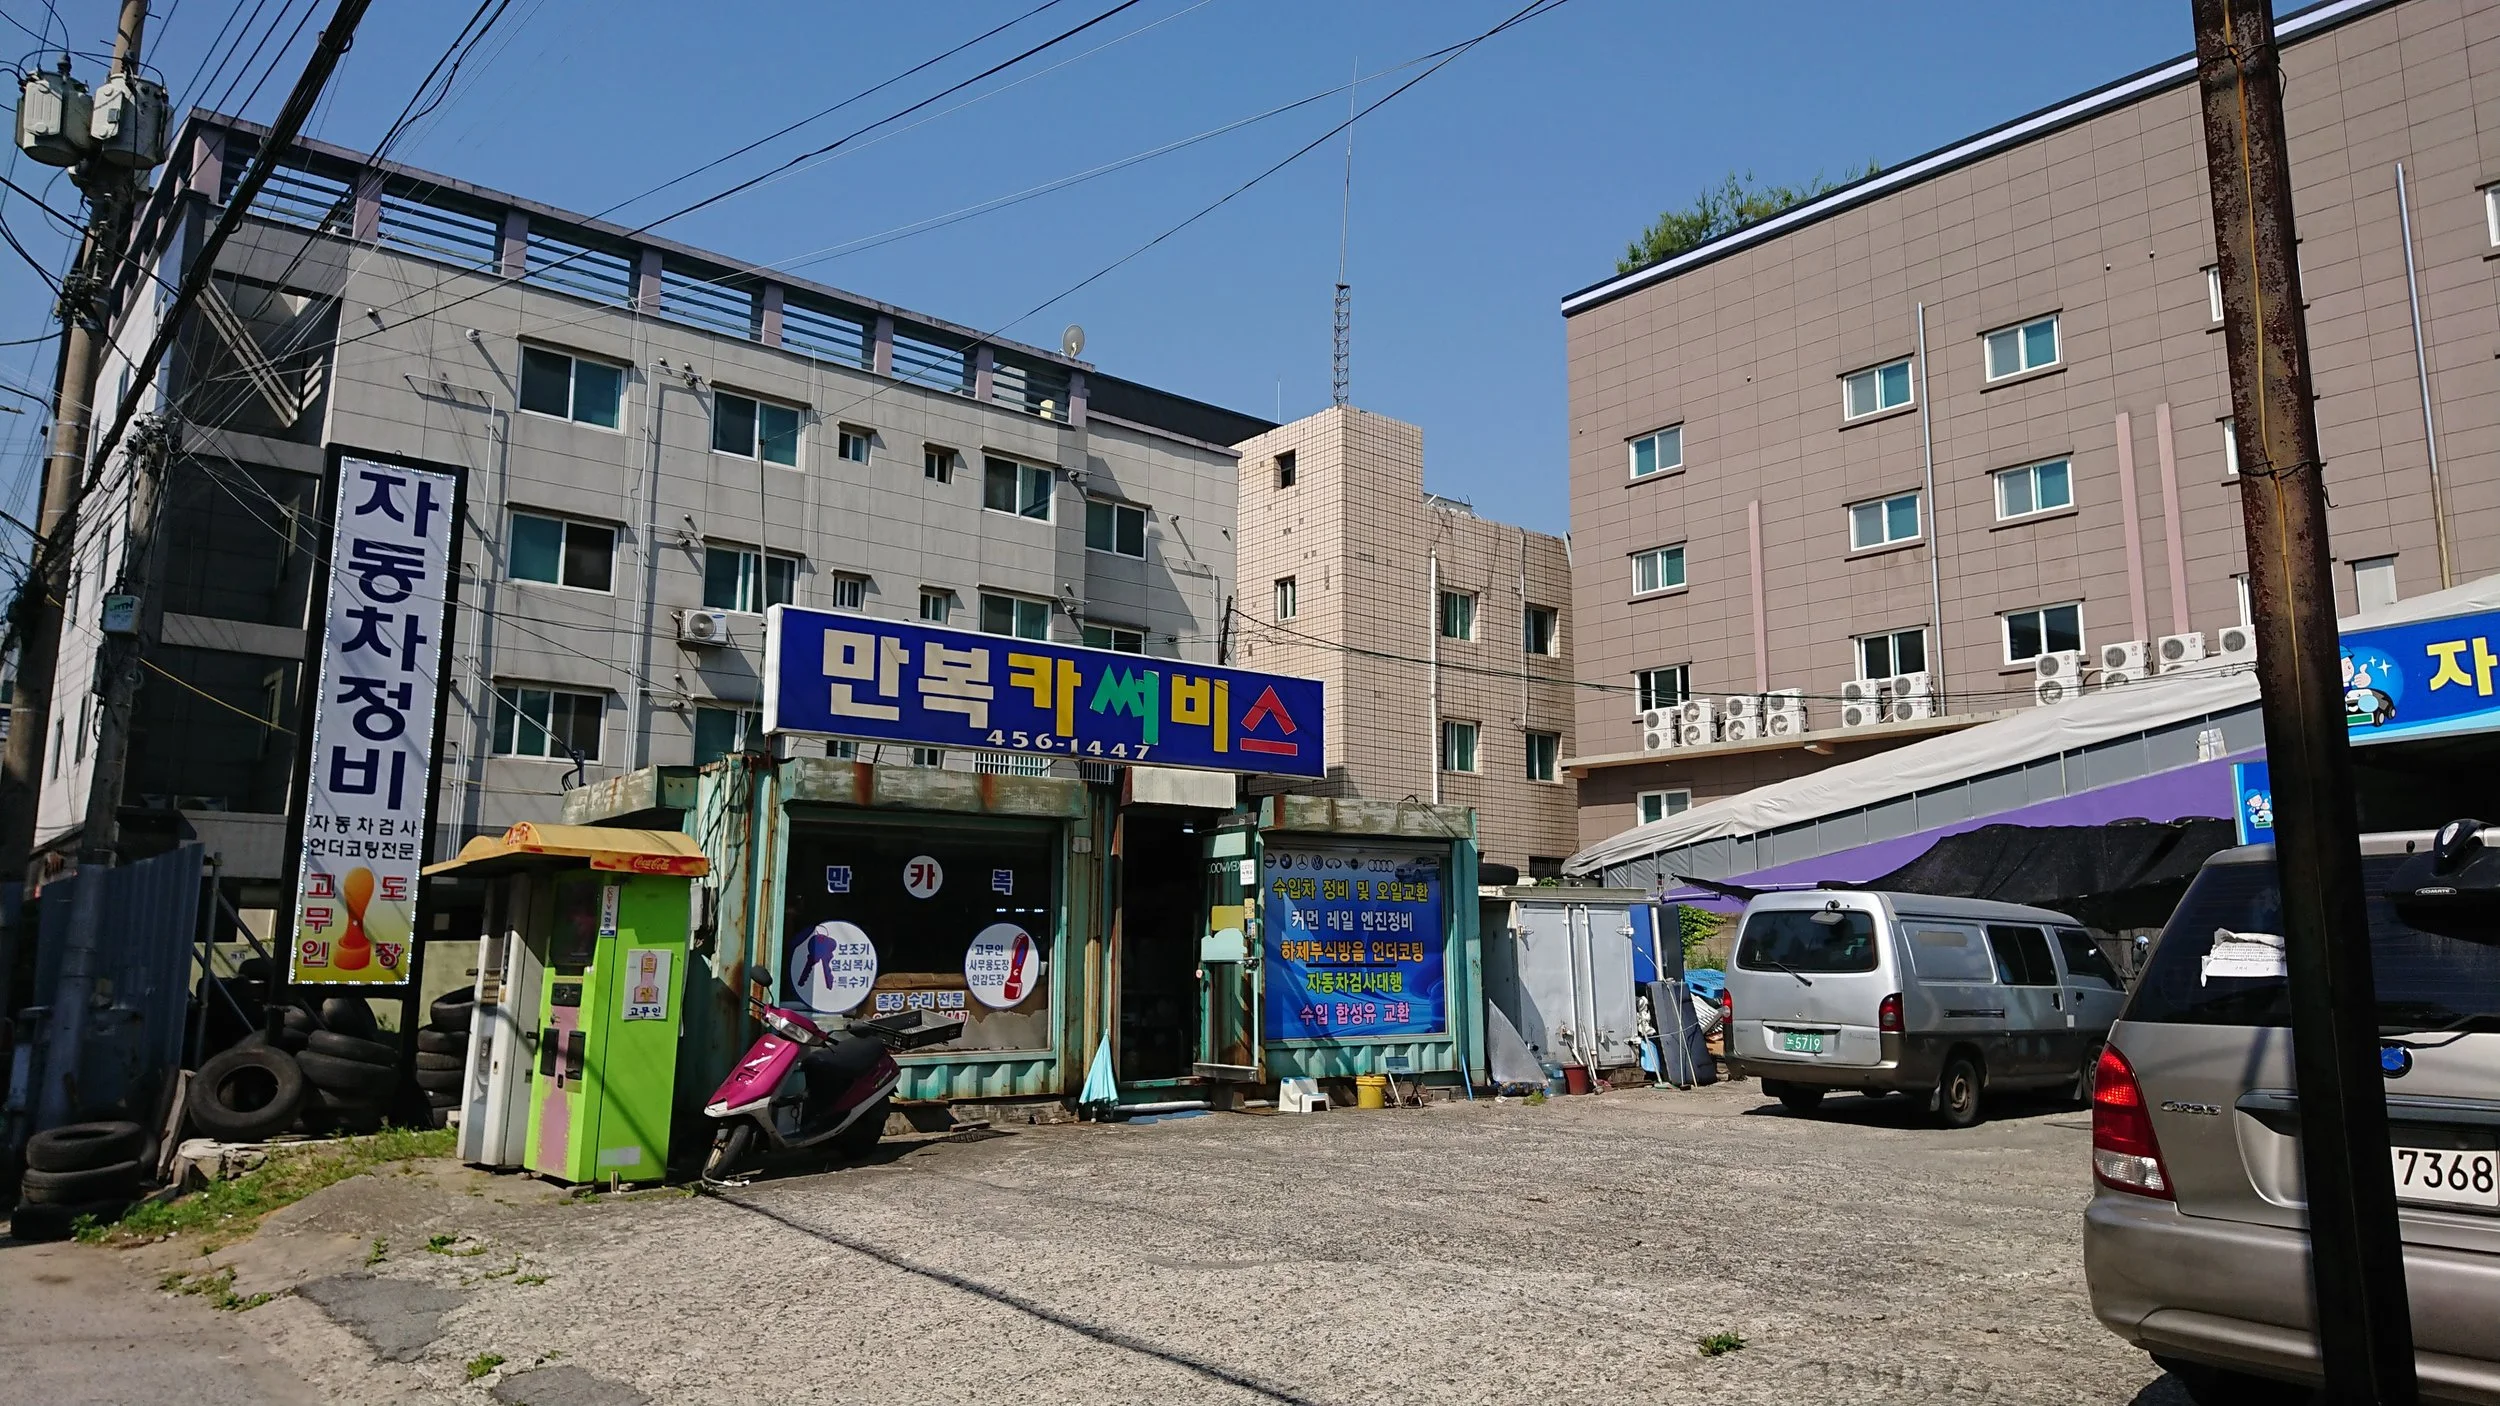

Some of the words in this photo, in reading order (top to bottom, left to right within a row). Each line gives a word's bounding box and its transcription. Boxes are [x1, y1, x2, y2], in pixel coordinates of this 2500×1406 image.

[329, 471, 440, 810] 자동차정비
[2426, 636, 2499, 697] 자
[986, 729, 1151, 761] 456-1447
[312, 814, 417, 838] 자동차검사
[309, 838, 415, 861] 언더코팅전문
[826, 865, 852, 893] 만
[910, 863, 936, 890] 카
[992, 869, 1013, 895] 복
[1272, 876, 1317, 900] 수입차
[1322, 879, 1350, 901] 정비
[1356, 880, 1371, 901] 및
[1376, 880, 1430, 903] 오일교환
[1291, 909, 1319, 931] 커먼
[1326, 910, 1354, 932] 레일
[1360, 910, 1413, 932] 엔진정비
[838, 943, 870, 956] 보조키
[974, 944, 1004, 957] 고무인
[1280, 940, 1366, 963] 하체부식방음
[1371, 941, 1424, 963] 언더코팅
[968, 959, 1010, 971] 사무용도장
[971, 974, 1005, 986] 인감도장
[1306, 971, 1403, 994] 자동차검사대행
[628, 1006, 661, 1018] 고무인
[876, 993, 904, 1010] 출장
[907, 992, 935, 1008] 수리
[937, 991, 964, 1008] 전문
[1300, 1003, 1329, 1027] 수입
[1335, 1001, 1377, 1025] 합성유
[1383, 1001, 1410, 1023] 교환
[1795, 1037, 1821, 1050] 5719
[2397, 1148, 2494, 1194] 7368
